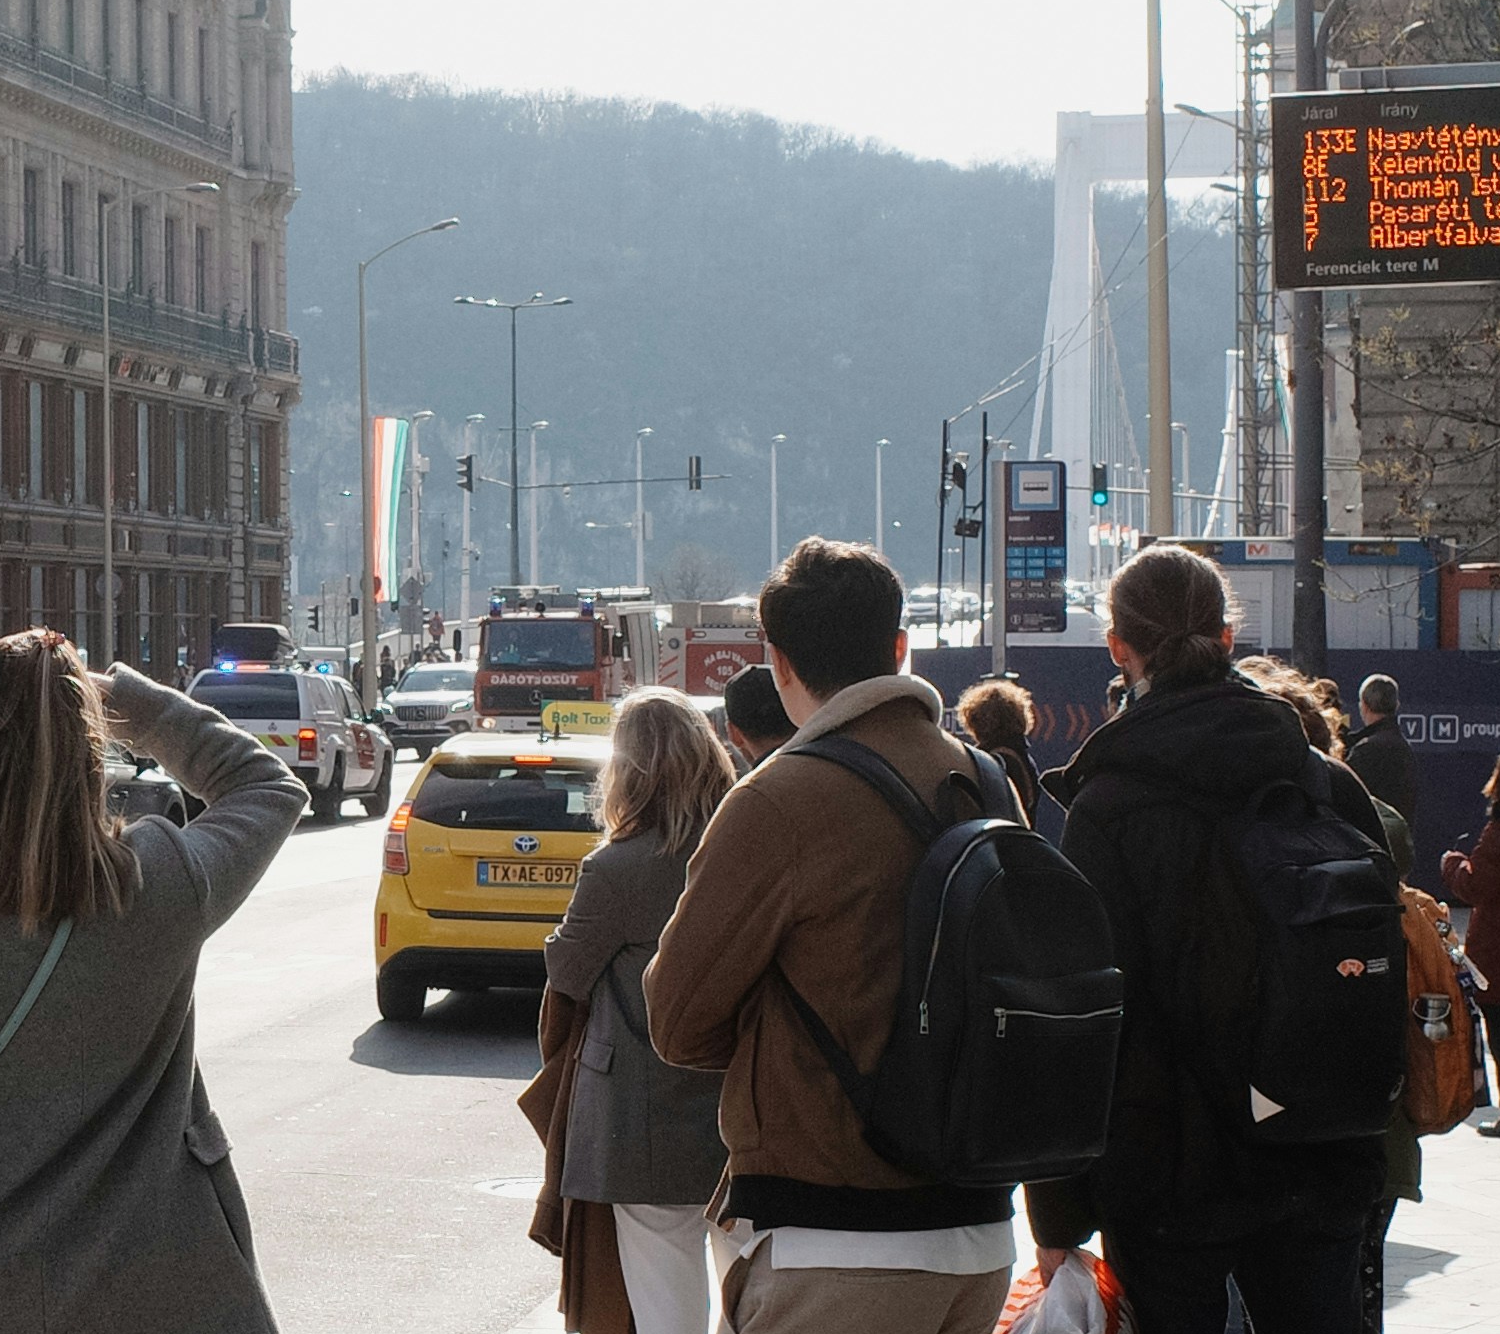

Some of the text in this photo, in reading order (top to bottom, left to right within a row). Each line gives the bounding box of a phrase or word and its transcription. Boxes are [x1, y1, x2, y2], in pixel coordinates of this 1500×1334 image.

[1380, 104, 1418, 118] Irány
[1304, 129, 1357, 154] 133E
[1303, 154, 1329, 178] 8E
[1369, 146, 1481, 175] Kelenföld
[1305, 177, 1347, 202] 112
[1370, 173, 1459, 200] Thomán
[1303, 203, 1319, 227] 5
[1370, 197, 1472, 224] Pasaréti
[1304, 228, 1320, 252] 7
[1305, 258, 1439, 276] Ferenciek tere M
[551, 711, 611, 725] Bolt Taxi
[490, 865, 574, 883] TX AE-097
